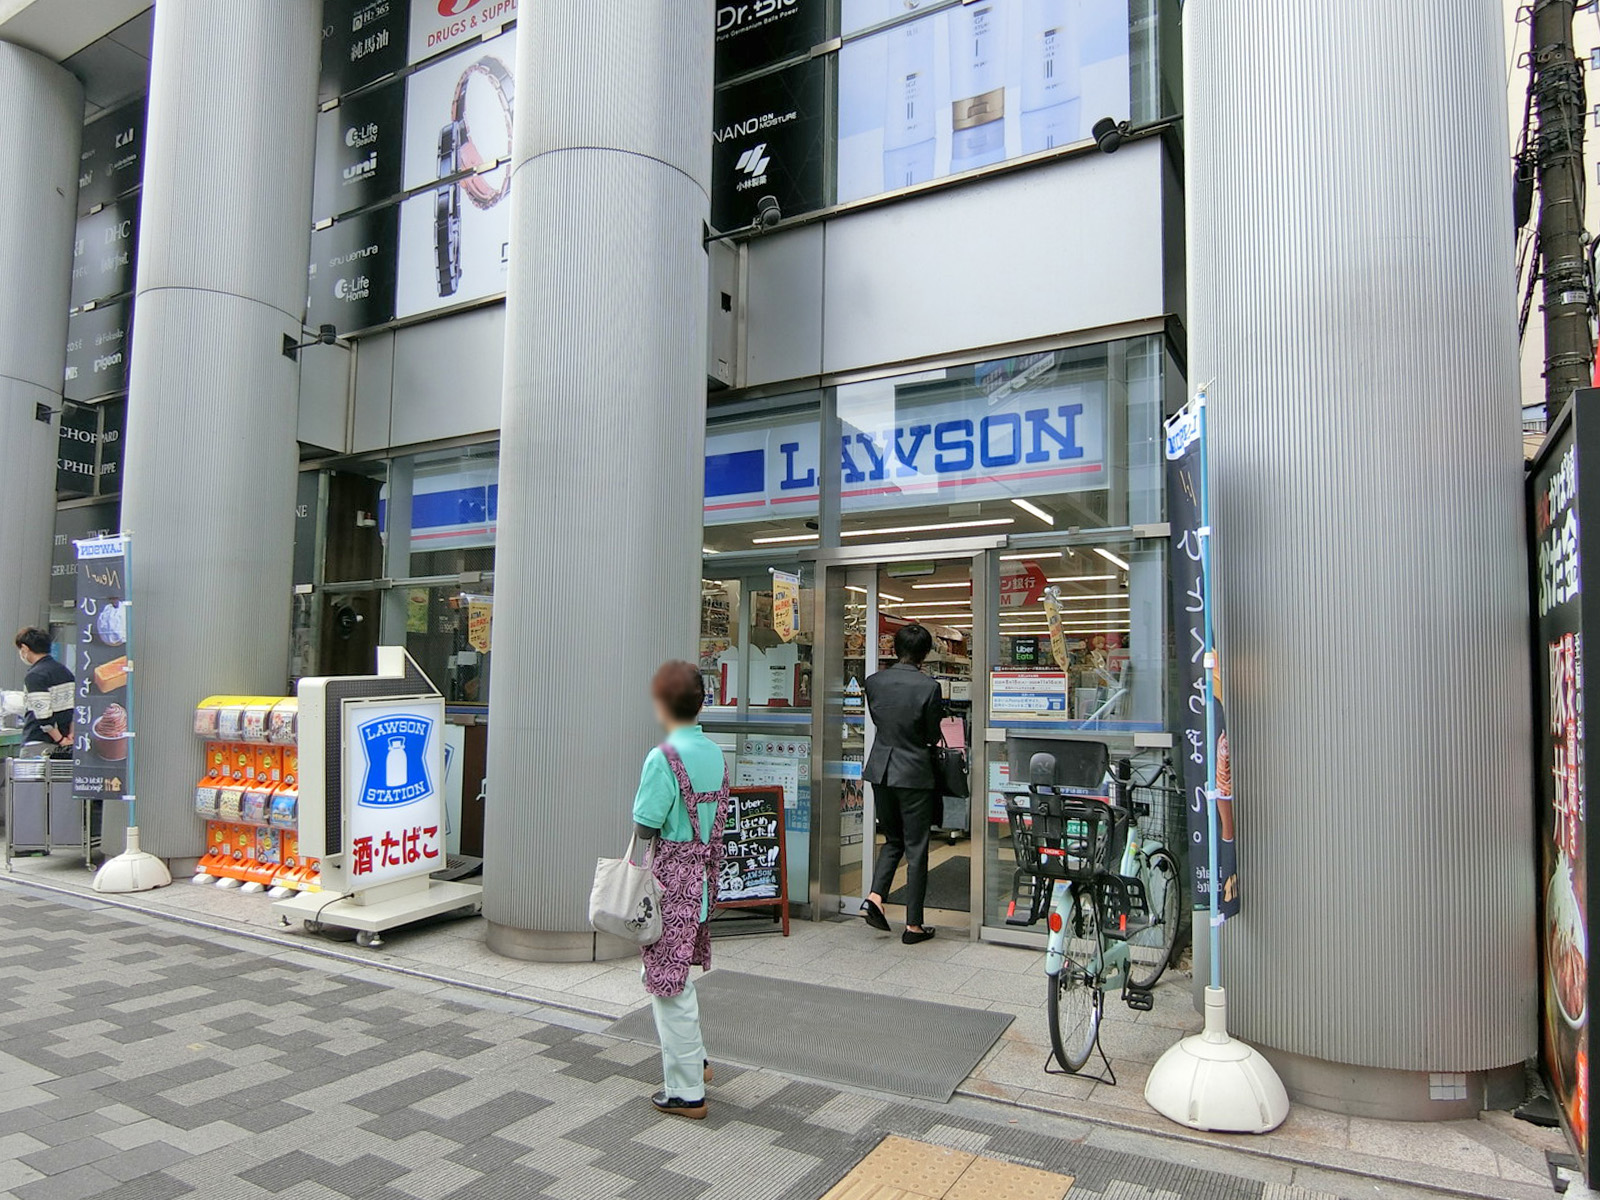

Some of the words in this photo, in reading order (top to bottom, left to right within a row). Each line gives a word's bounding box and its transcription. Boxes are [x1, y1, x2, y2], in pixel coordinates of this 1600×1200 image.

[780, 8, 798, 18] Power
[427, 19, 466, 47] DRUGS
[469, 15, 478, 28] &
[759, 112, 774, 122] ION
[713, 118, 759, 143] NANO
[343, 151, 378, 179] uni
[104, 220, 131, 245] DHC
[346, 289, 370, 302] Home
[780, 403, 1084, 490] LAWSON
[1016, 645, 1034, 653] Uber
[1016, 653, 1034, 661] Eats
[365, 720, 426, 740] LAWSON
[366, 781, 426, 802] STATION
[740, 799, 764, 811] Uber
[740, 816, 768, 829] はじめ
[352, 826, 439, 876] 酒・たばこ
[741, 869, 773, 882] LAWSON
